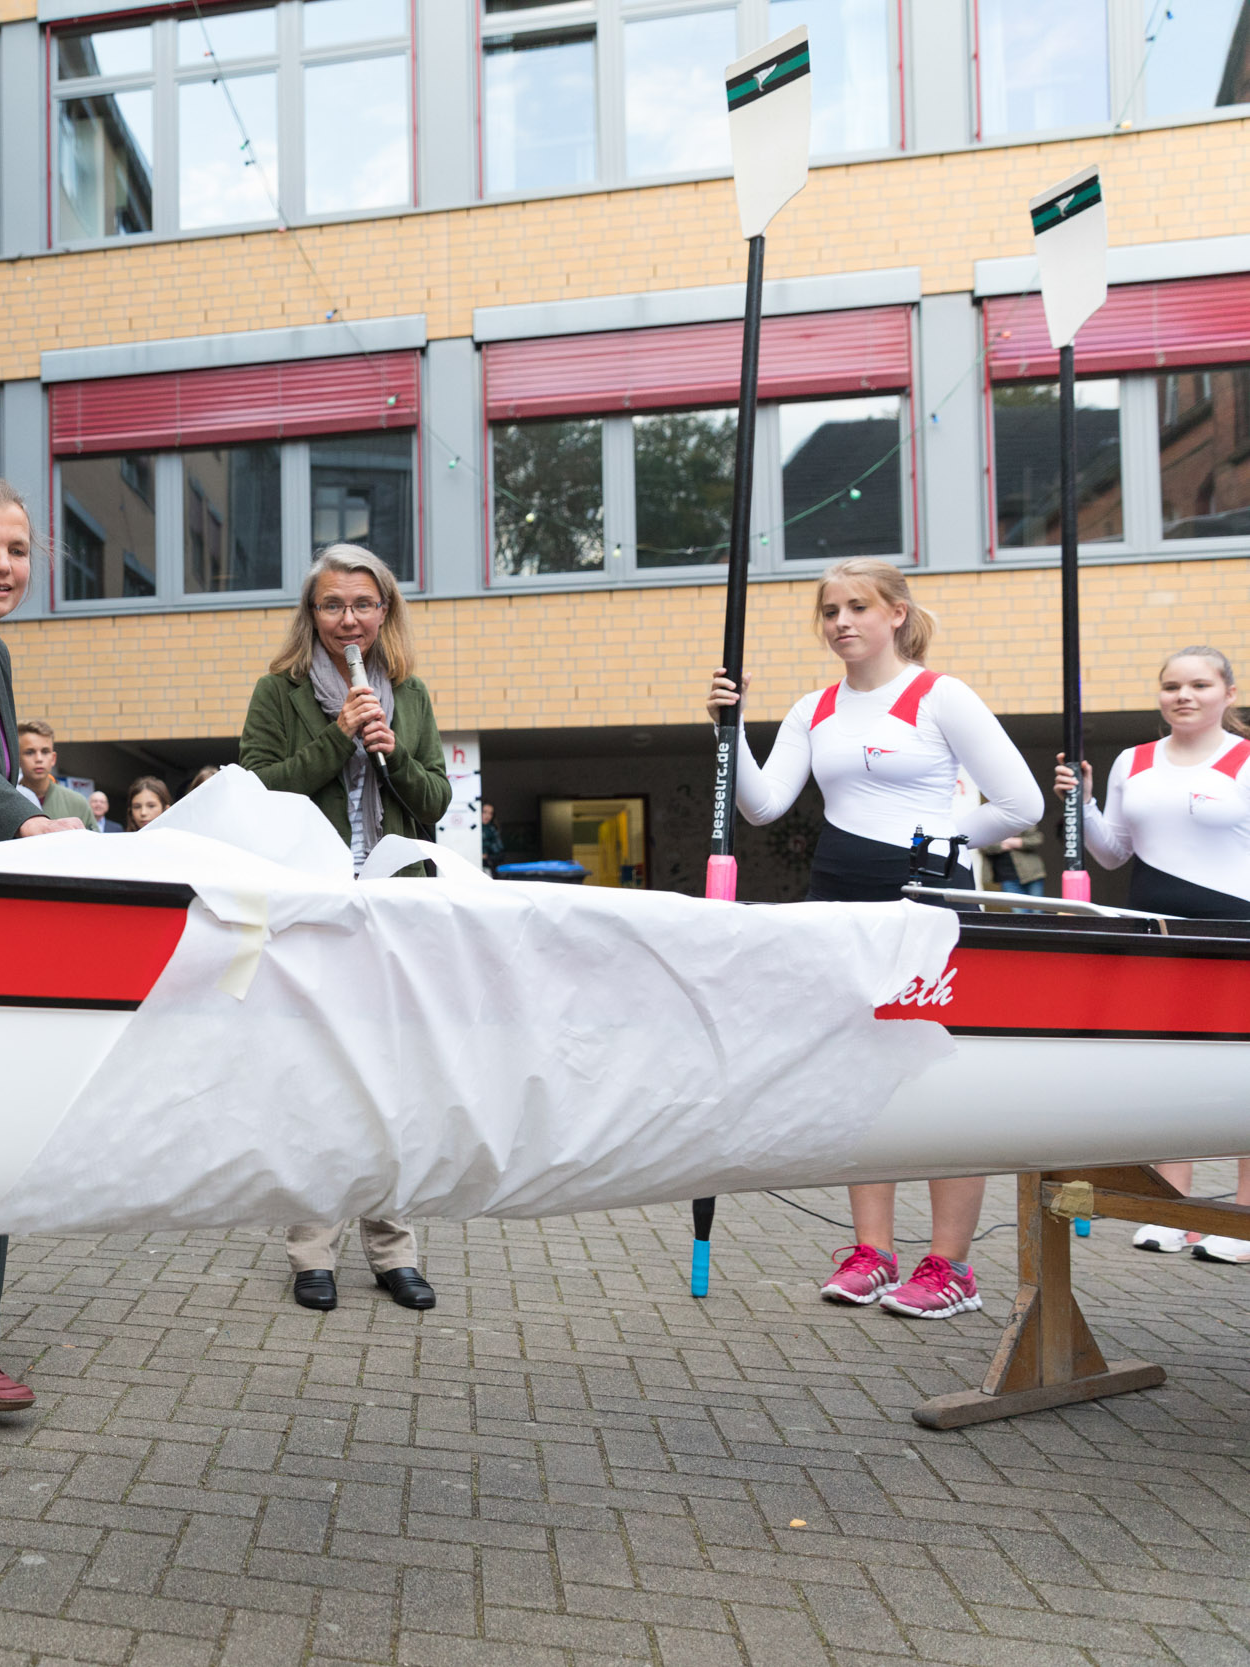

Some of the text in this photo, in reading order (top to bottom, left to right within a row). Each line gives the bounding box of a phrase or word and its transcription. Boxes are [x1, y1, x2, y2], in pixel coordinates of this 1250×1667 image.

[711, 742, 729, 839] besselrc.de
[1063, 777, 1077, 858] besselrc.
[887, 967, 958, 1007] eth
